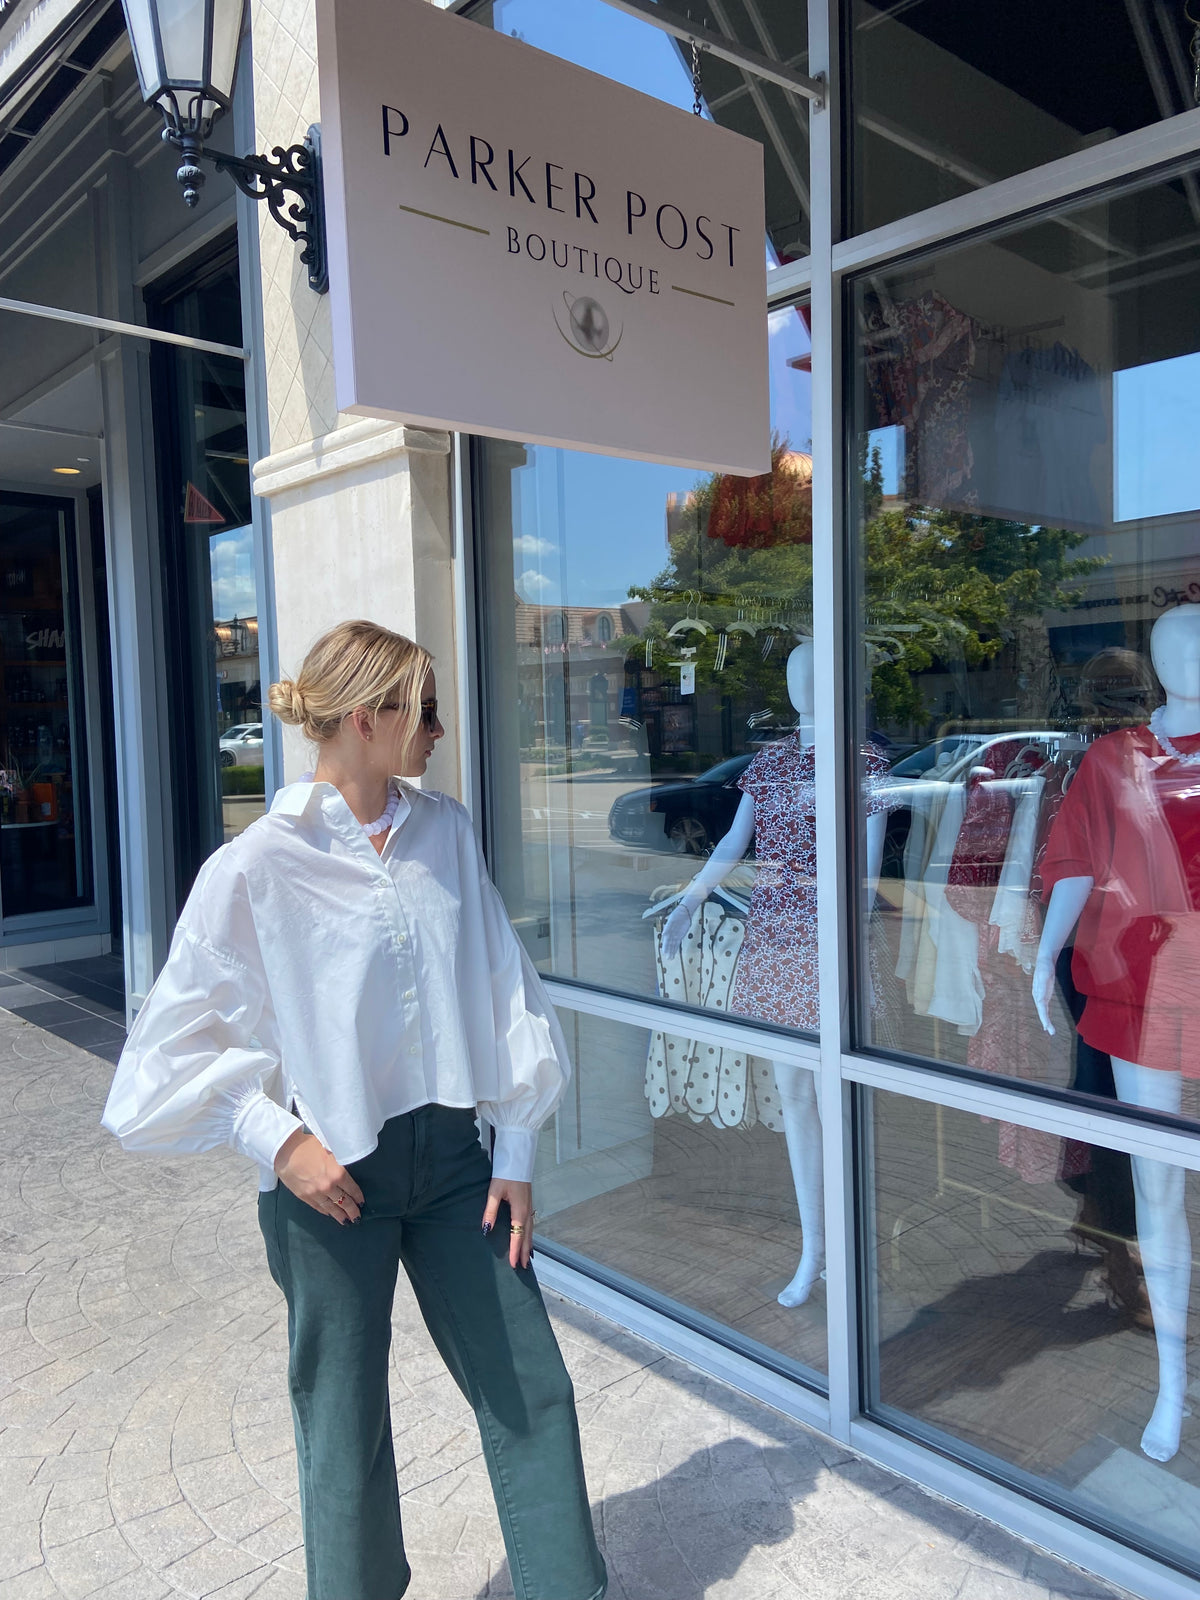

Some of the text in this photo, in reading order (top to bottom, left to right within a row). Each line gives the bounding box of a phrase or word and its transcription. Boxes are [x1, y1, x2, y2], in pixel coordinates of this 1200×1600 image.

[381, 104, 742, 268] PARKER POST
[506, 226, 660, 295] BOUTIQUE
